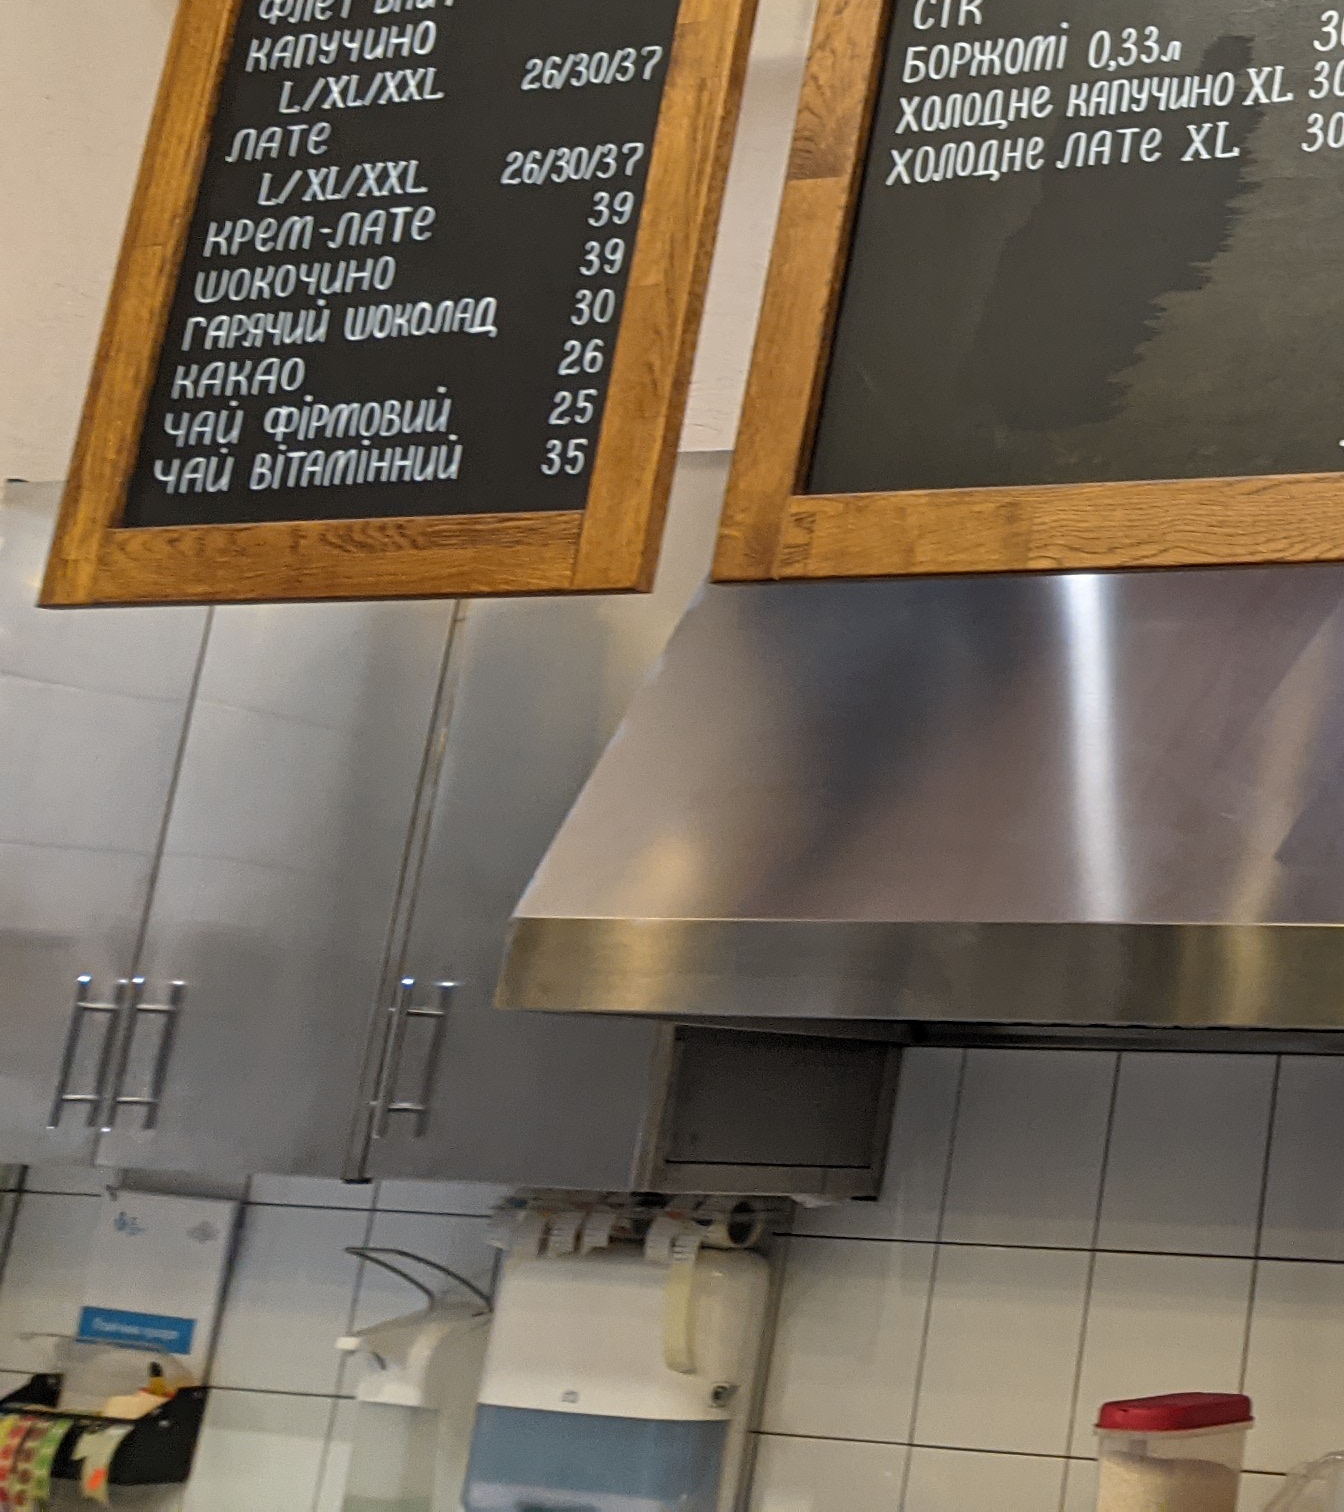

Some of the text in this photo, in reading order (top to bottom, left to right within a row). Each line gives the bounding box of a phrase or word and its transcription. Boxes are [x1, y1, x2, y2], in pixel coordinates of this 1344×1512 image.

[246, 19, 437, 72] КАПУЧИНО
[902, 21, 1069, 84] БОРЖОМІ
[278, 45, 663, 114] L/XL/XXL 26/30/37
[1066, 69, 1236, 119] КАПУЧИНО
[1240, 64, 1294, 107] XL
[1180, 120, 1240, 162] XL
[257, 142, 644, 206] L/XL/XXL 26/30/37
[195, 237, 625, 304] ШОКОЧИНО 39
[183, 296, 498, 350] ГАРЯЧИЙ ШОКОЛАД
[173, 338, 604, 399] КАКАО 26
[164, 385, 452, 448] ЧАЙ ФІРМОВИЙ
[154, 433, 588, 493] ЧАЙ ВІТАМІННИЙ 35
